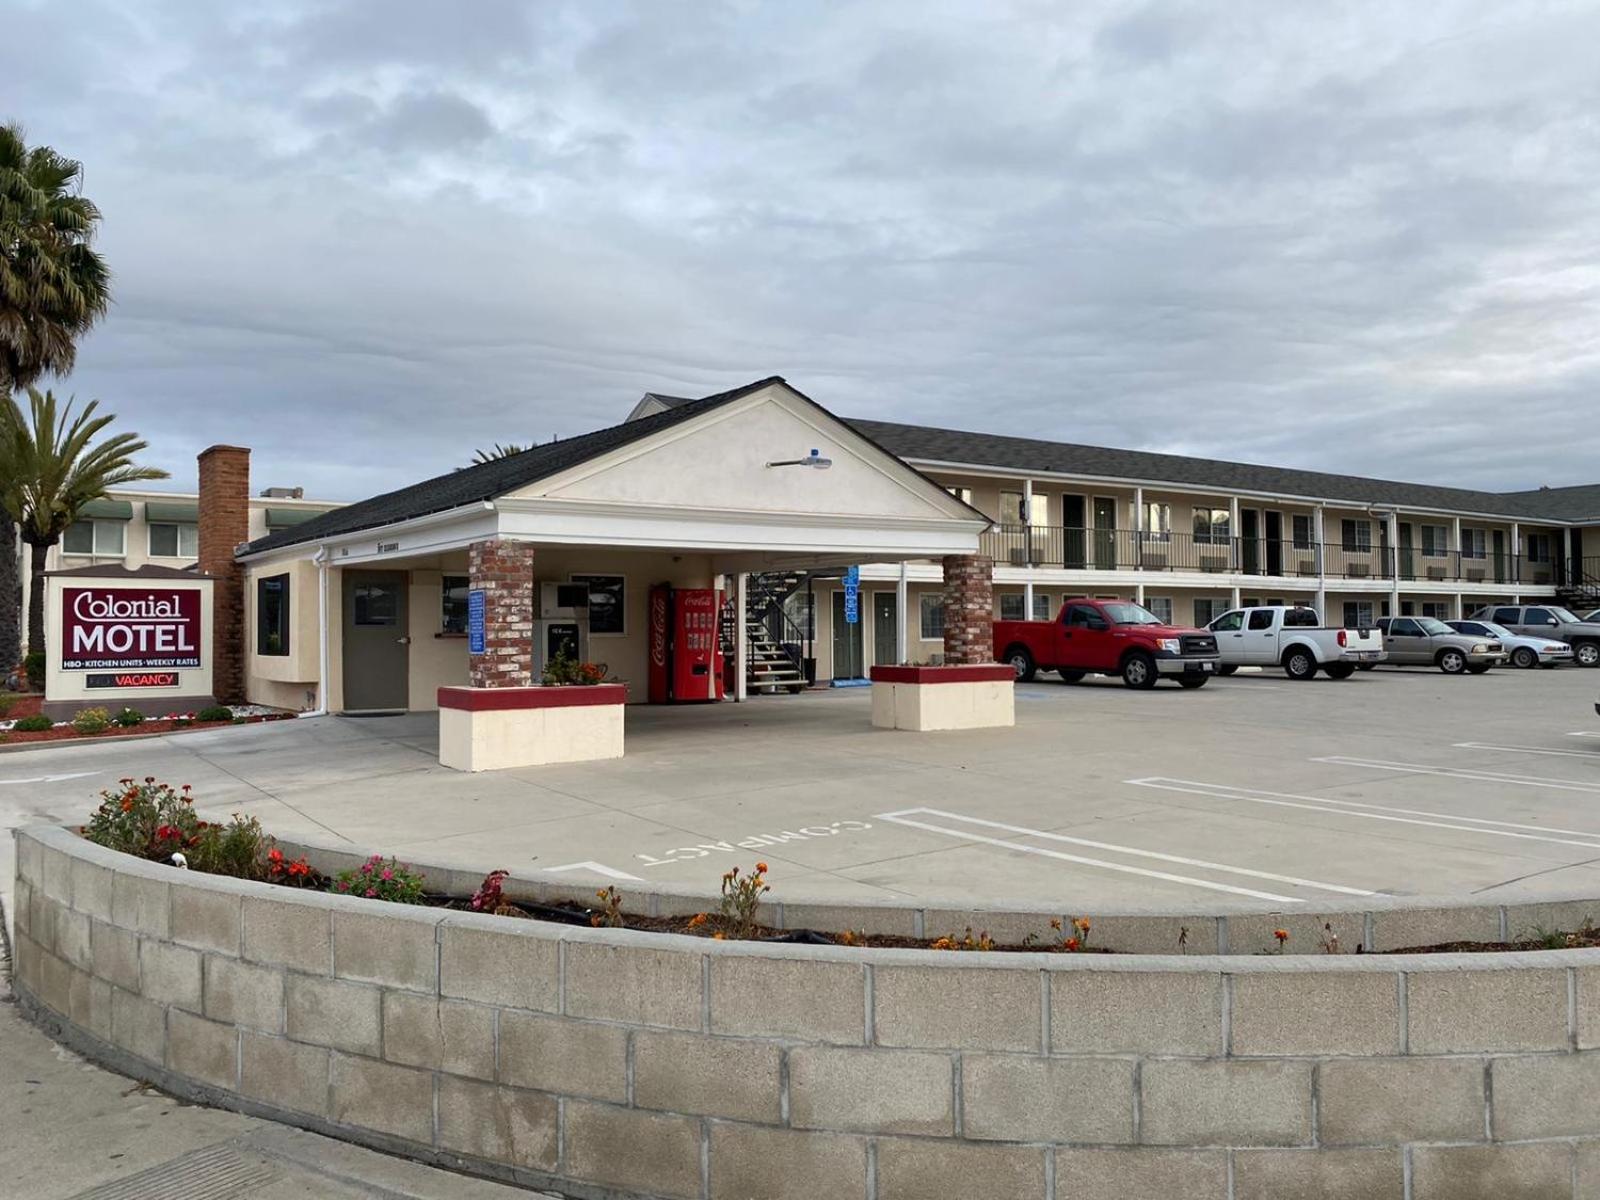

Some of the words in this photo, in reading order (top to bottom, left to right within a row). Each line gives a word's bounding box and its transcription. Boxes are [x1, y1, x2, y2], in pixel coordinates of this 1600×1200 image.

[74, 591, 190, 622] Colonial
[73, 625, 194, 652] MOTEL
[64, 660, 81, 668] HBO
[120, 659, 143, 667] UNITS
[115, 674, 174, 686] VACANCY
[637, 820, 873, 866] COMPACT
